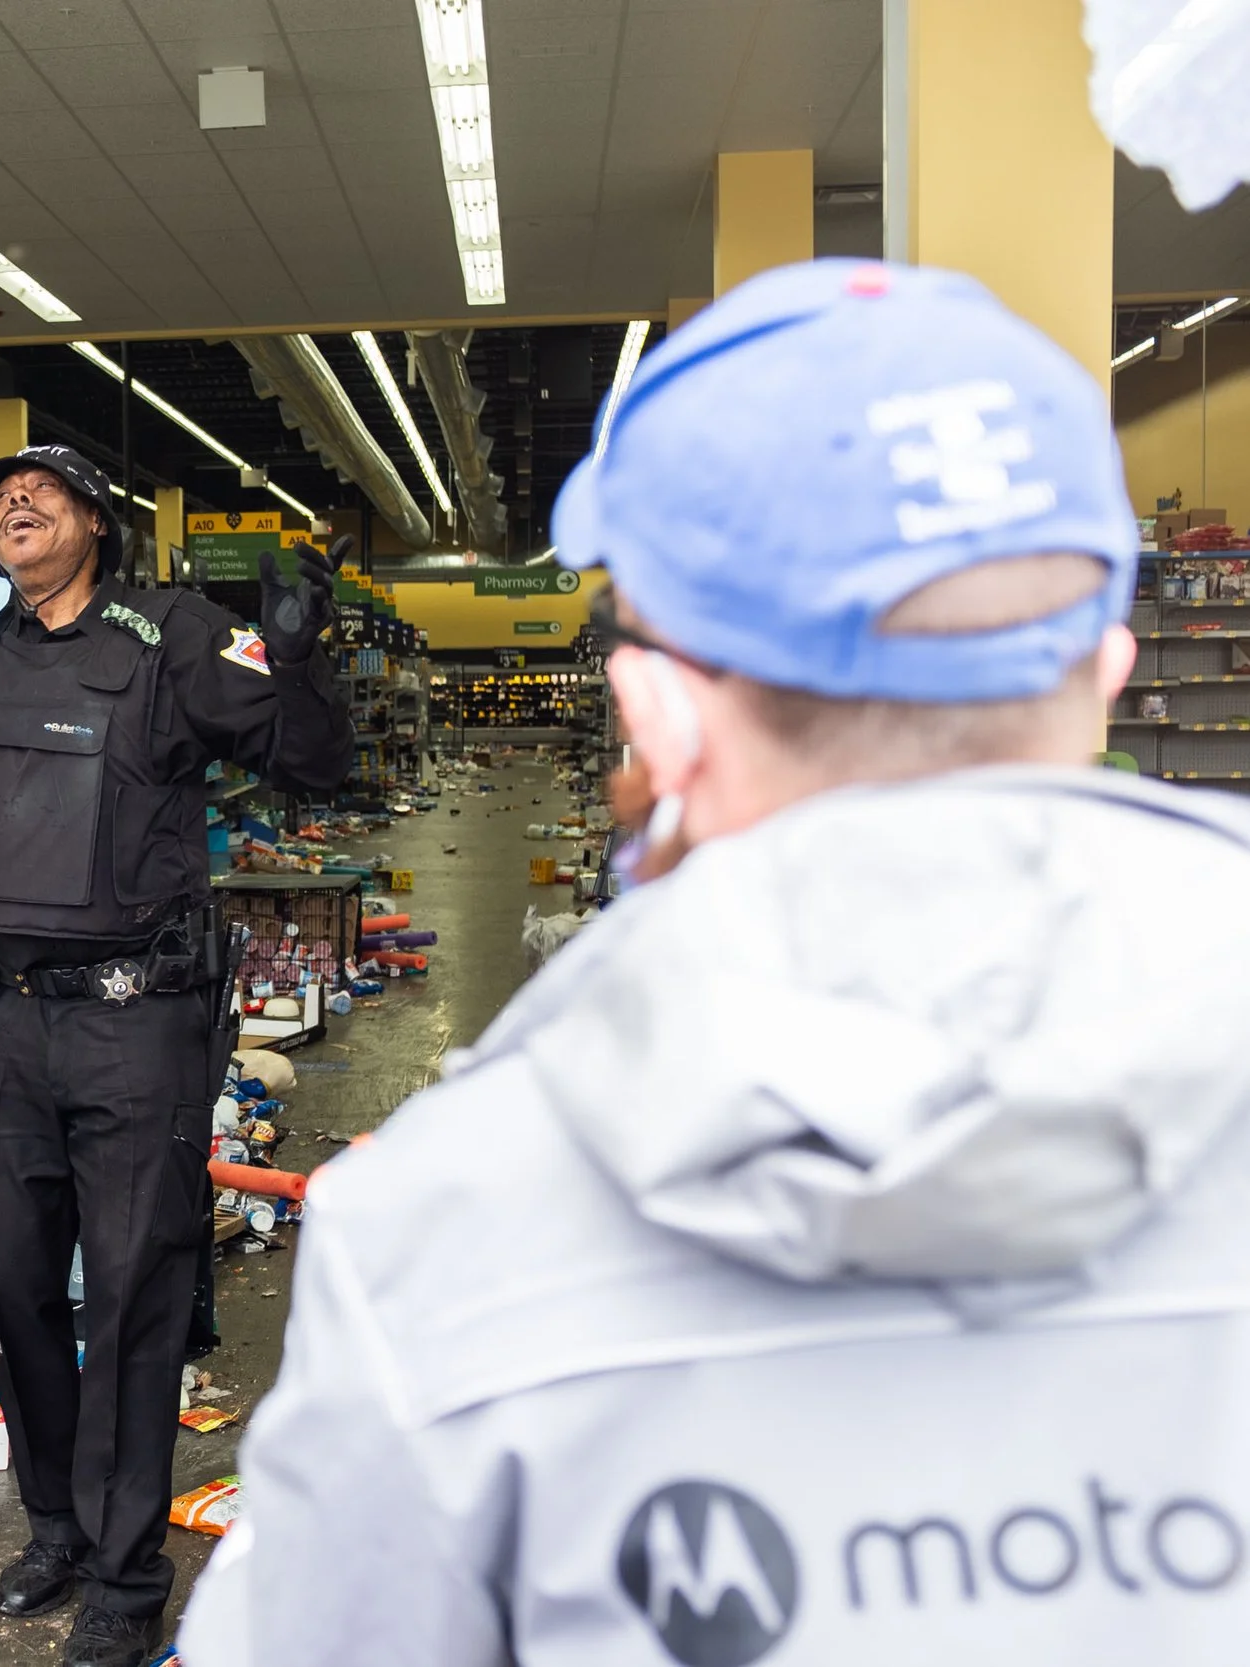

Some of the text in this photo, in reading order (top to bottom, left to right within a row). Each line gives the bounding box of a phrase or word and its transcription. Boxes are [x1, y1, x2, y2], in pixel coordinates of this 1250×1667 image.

[194, 518, 273, 531] A10 A11
[212, 549, 238, 557] Drinks
[484, 576, 548, 591] Pharmacy
[843, 1474, 1247, 1612] moto
